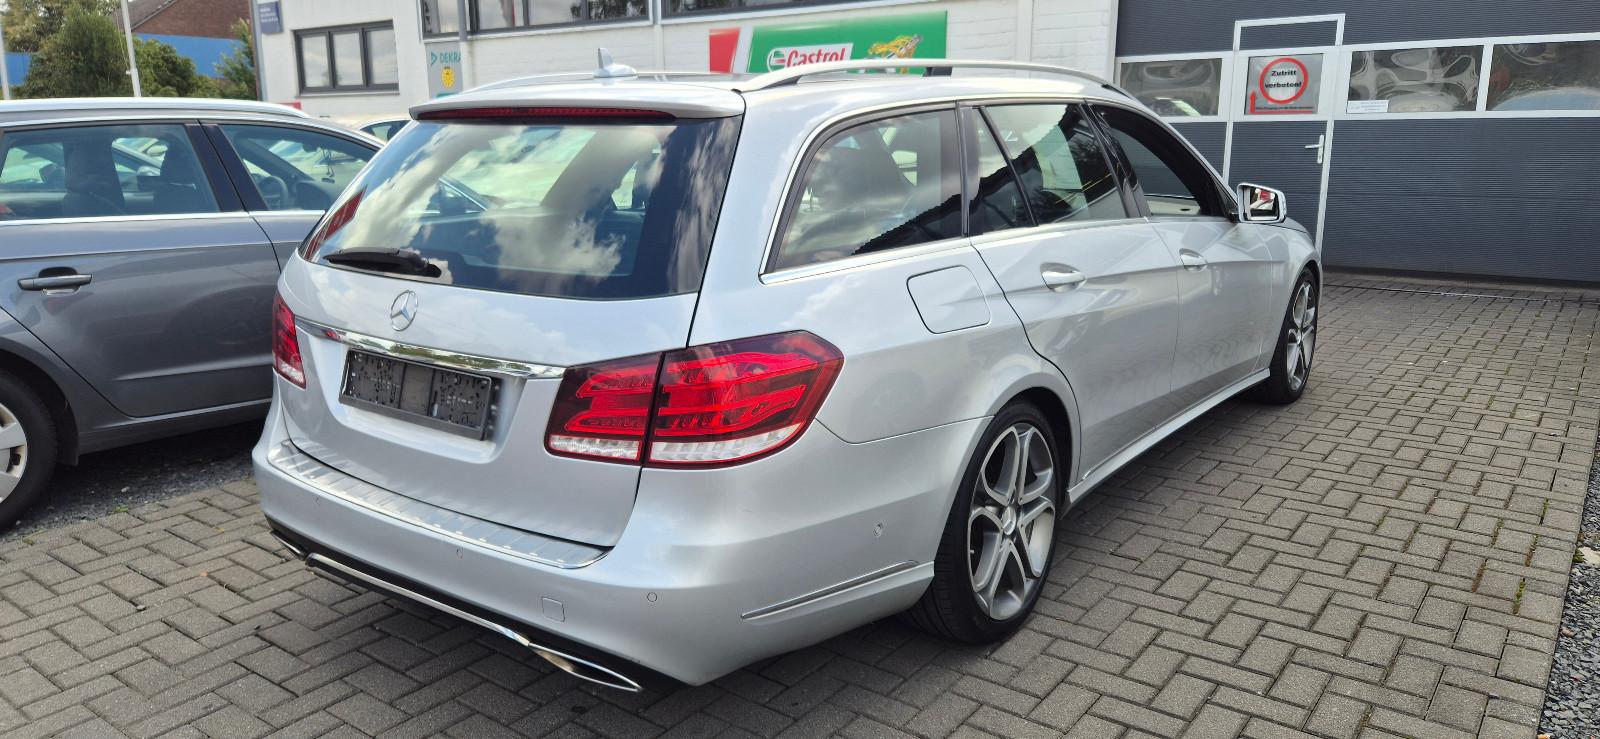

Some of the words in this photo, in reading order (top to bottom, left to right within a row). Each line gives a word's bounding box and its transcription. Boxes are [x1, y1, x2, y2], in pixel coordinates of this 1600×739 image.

[787, 47, 846, 67] Castrol
[1271, 69, 1297, 77] Zutritt
[1264, 81, 1302, 89] verboten!
